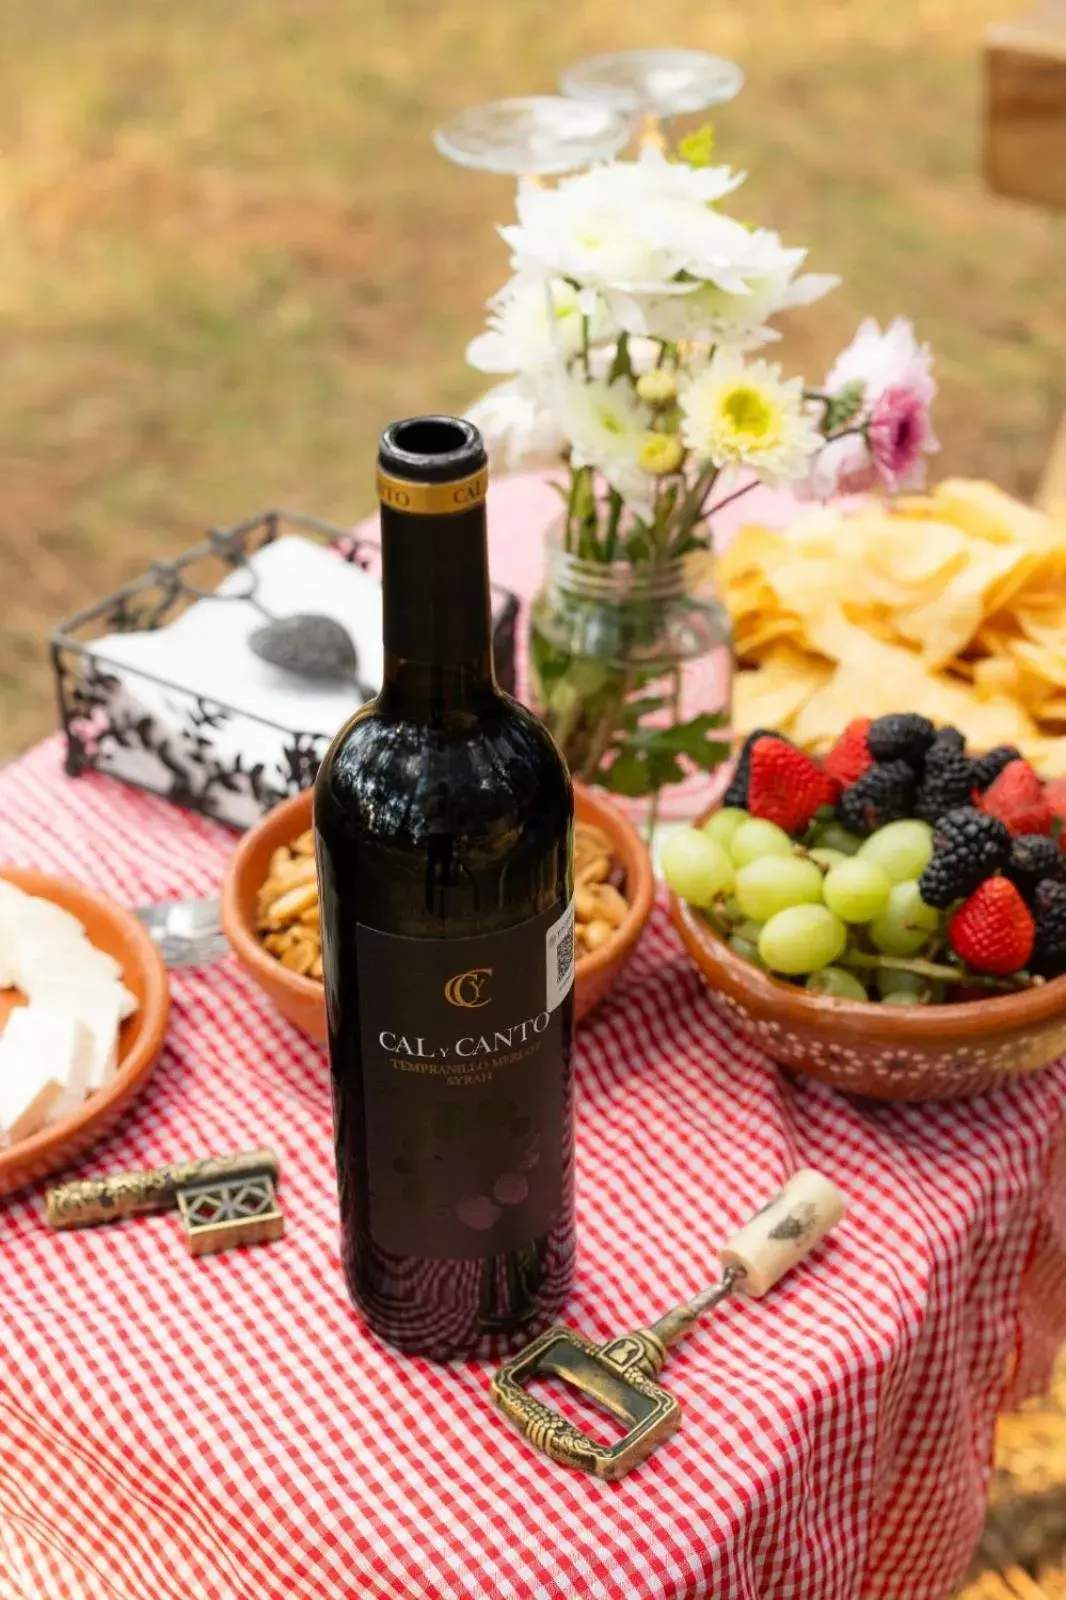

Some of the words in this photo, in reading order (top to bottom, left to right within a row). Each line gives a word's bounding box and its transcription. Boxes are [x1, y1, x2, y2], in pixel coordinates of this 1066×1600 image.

[378, 1031, 436, 1058] CAL
[455, 1011, 551, 1057] CANTO
[390, 1058, 490, 1076] TEMPRANILLO
[491, 1040, 543, 1068] MERLOT
[446, 1072, 493, 1086] SYRAH
